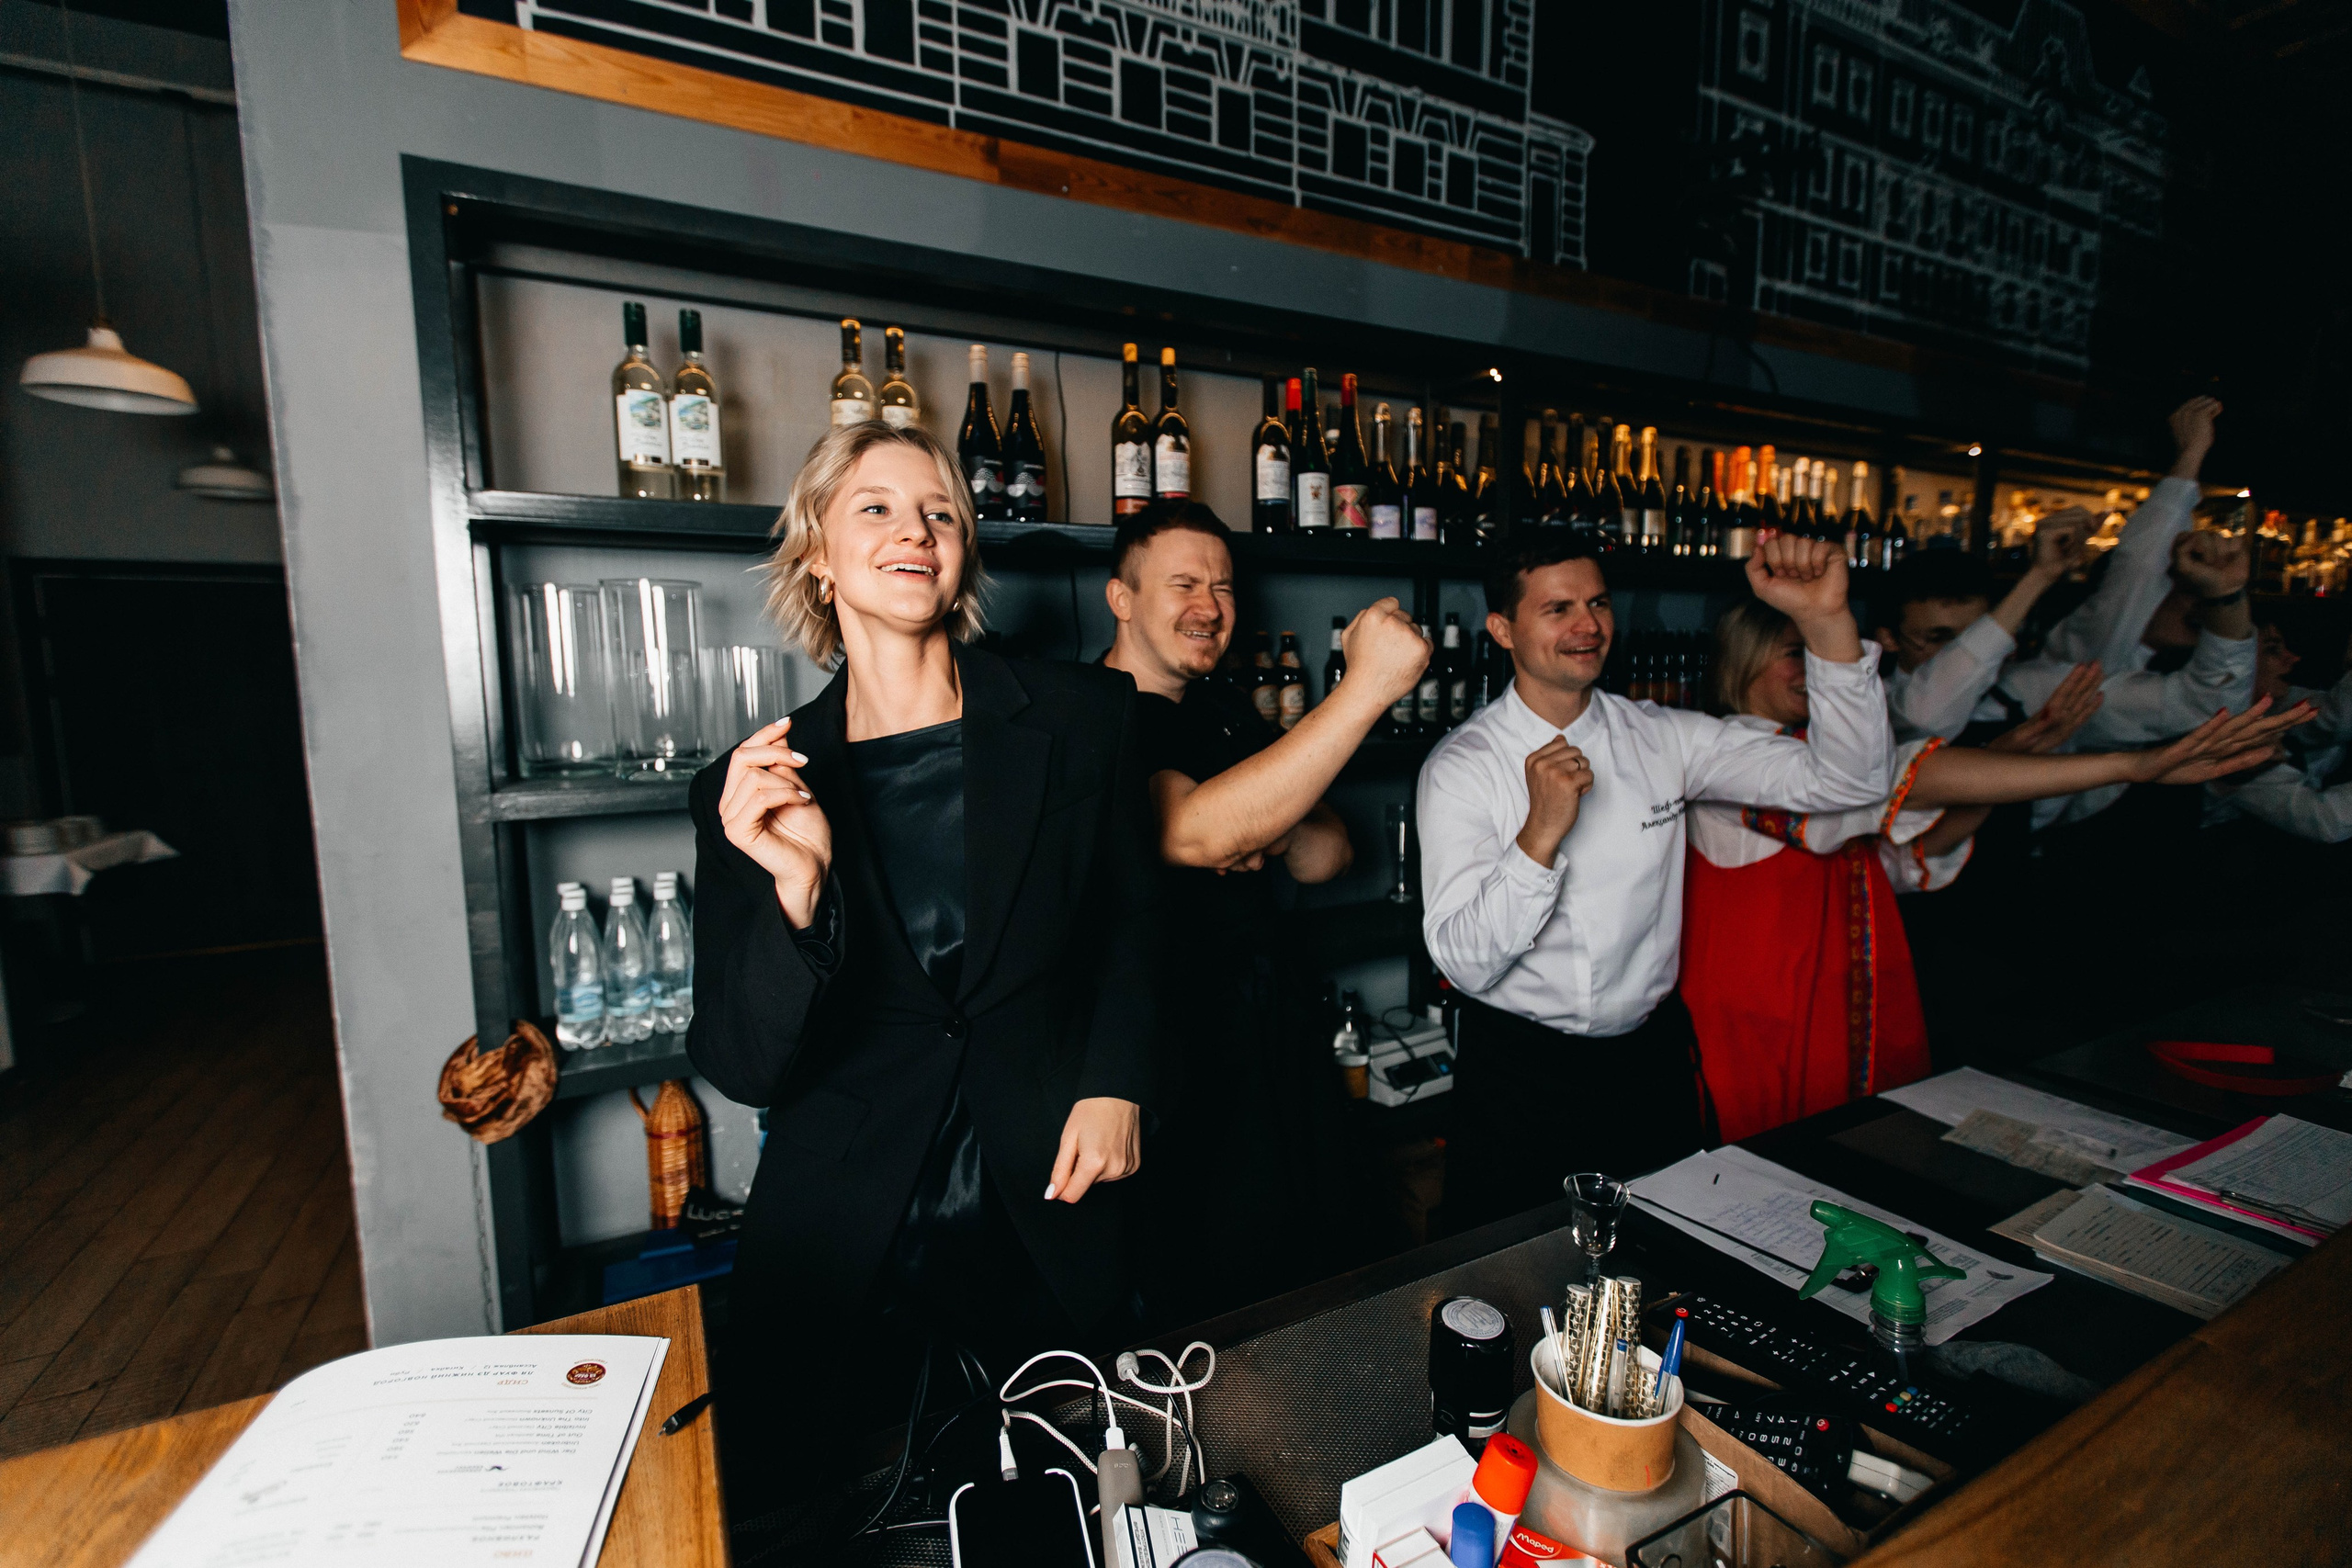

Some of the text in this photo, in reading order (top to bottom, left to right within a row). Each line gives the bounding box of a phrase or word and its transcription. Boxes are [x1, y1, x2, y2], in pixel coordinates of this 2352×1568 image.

[373, 1374, 427, 1386] НОВГОРОД
[1760, 1434, 1768, 1442] 8
[1771, 1436, 1779, 1444] 5
[1782, 1437, 1792, 1446] 2
[1778, 1458, 1786, 1466] 3
[1170, 1517, 1188, 1557] HEE
[1517, 1532, 1555, 1553] Maped
[1140, 1529, 1150, 1568] УПОТРЕБЛЕ
